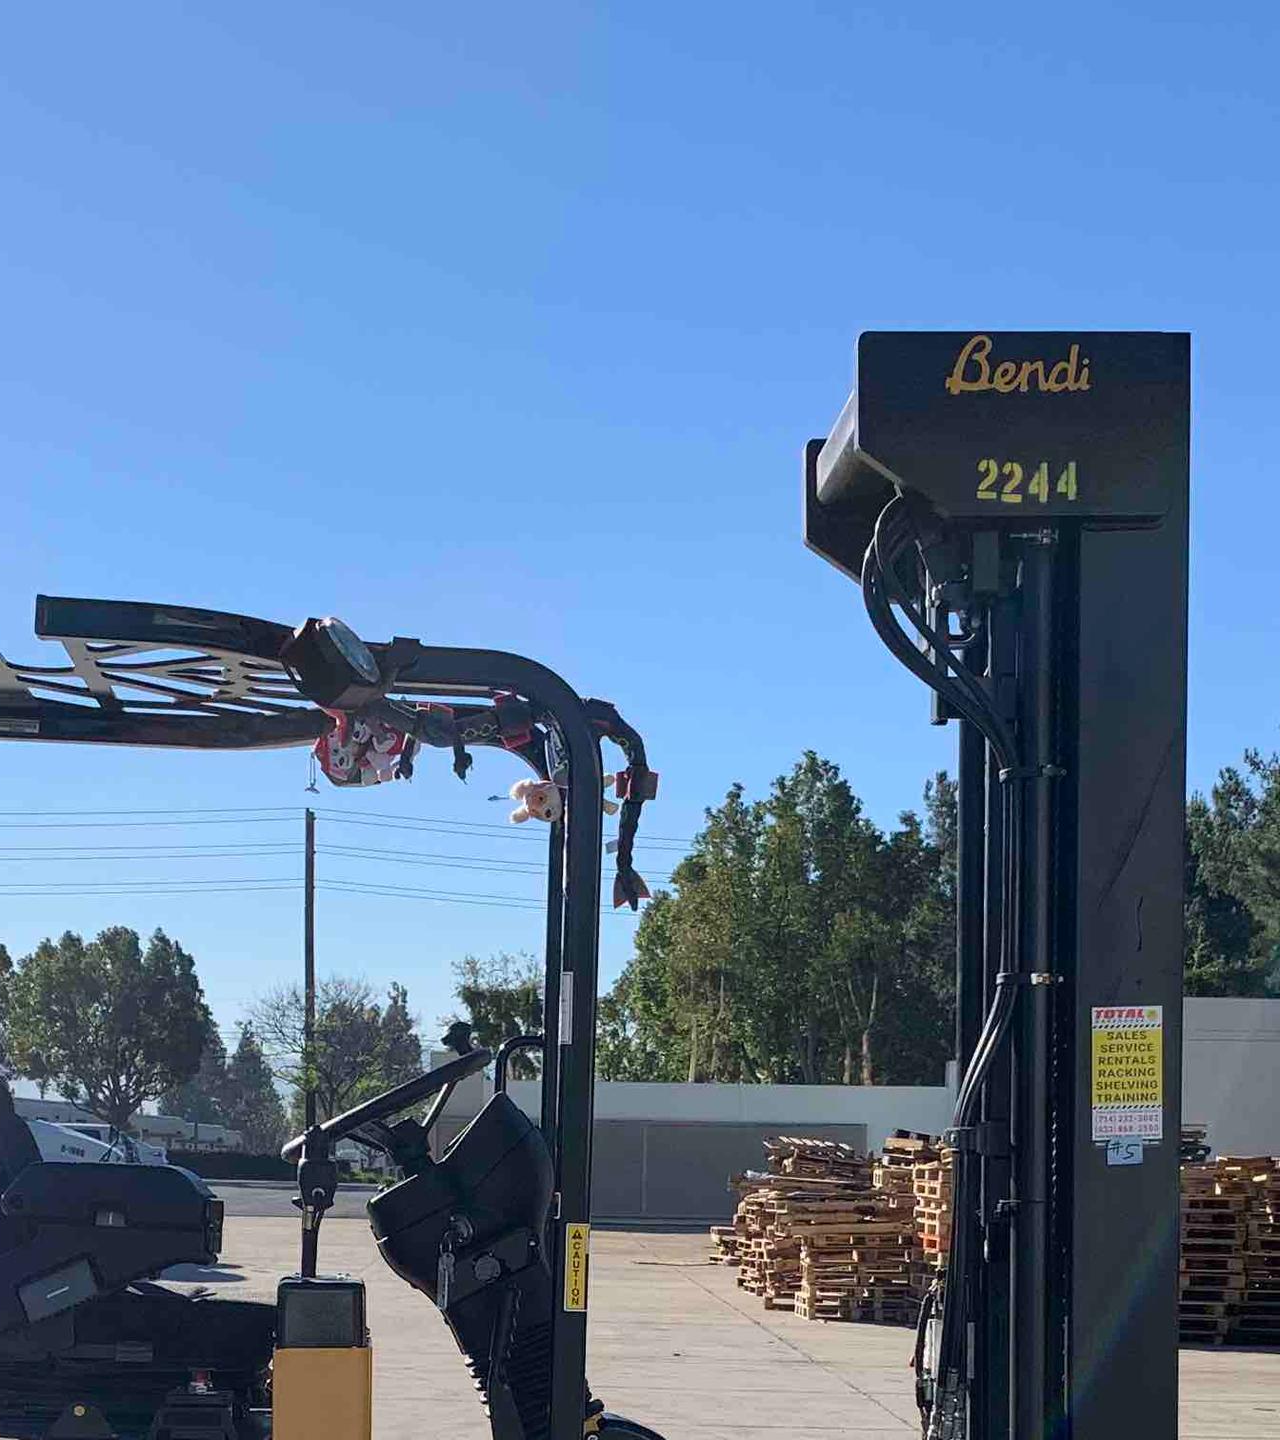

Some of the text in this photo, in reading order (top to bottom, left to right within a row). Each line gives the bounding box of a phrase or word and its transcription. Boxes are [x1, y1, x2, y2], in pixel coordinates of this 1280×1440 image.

[945, 334, 1094, 395] Bendi
[976, 458, 1078, 503] 2244
[1094, 1008, 1145, 1020] TOTAL
[1106, 1030, 1148, 1041] SALES
[1100, 1043, 1154, 1054] SERVICE
[1098, 1055, 1157, 1066] RENTALS
[1098, 1067, 1156, 1079] RACKING
[1095, 1079, 1158, 1091] SHELVING
[1096, 1092, 1158, 1104] TRAINING
[1107, 1141, 1140, 1160] #5
[571, 1241, 581, 1306] CAUTION
